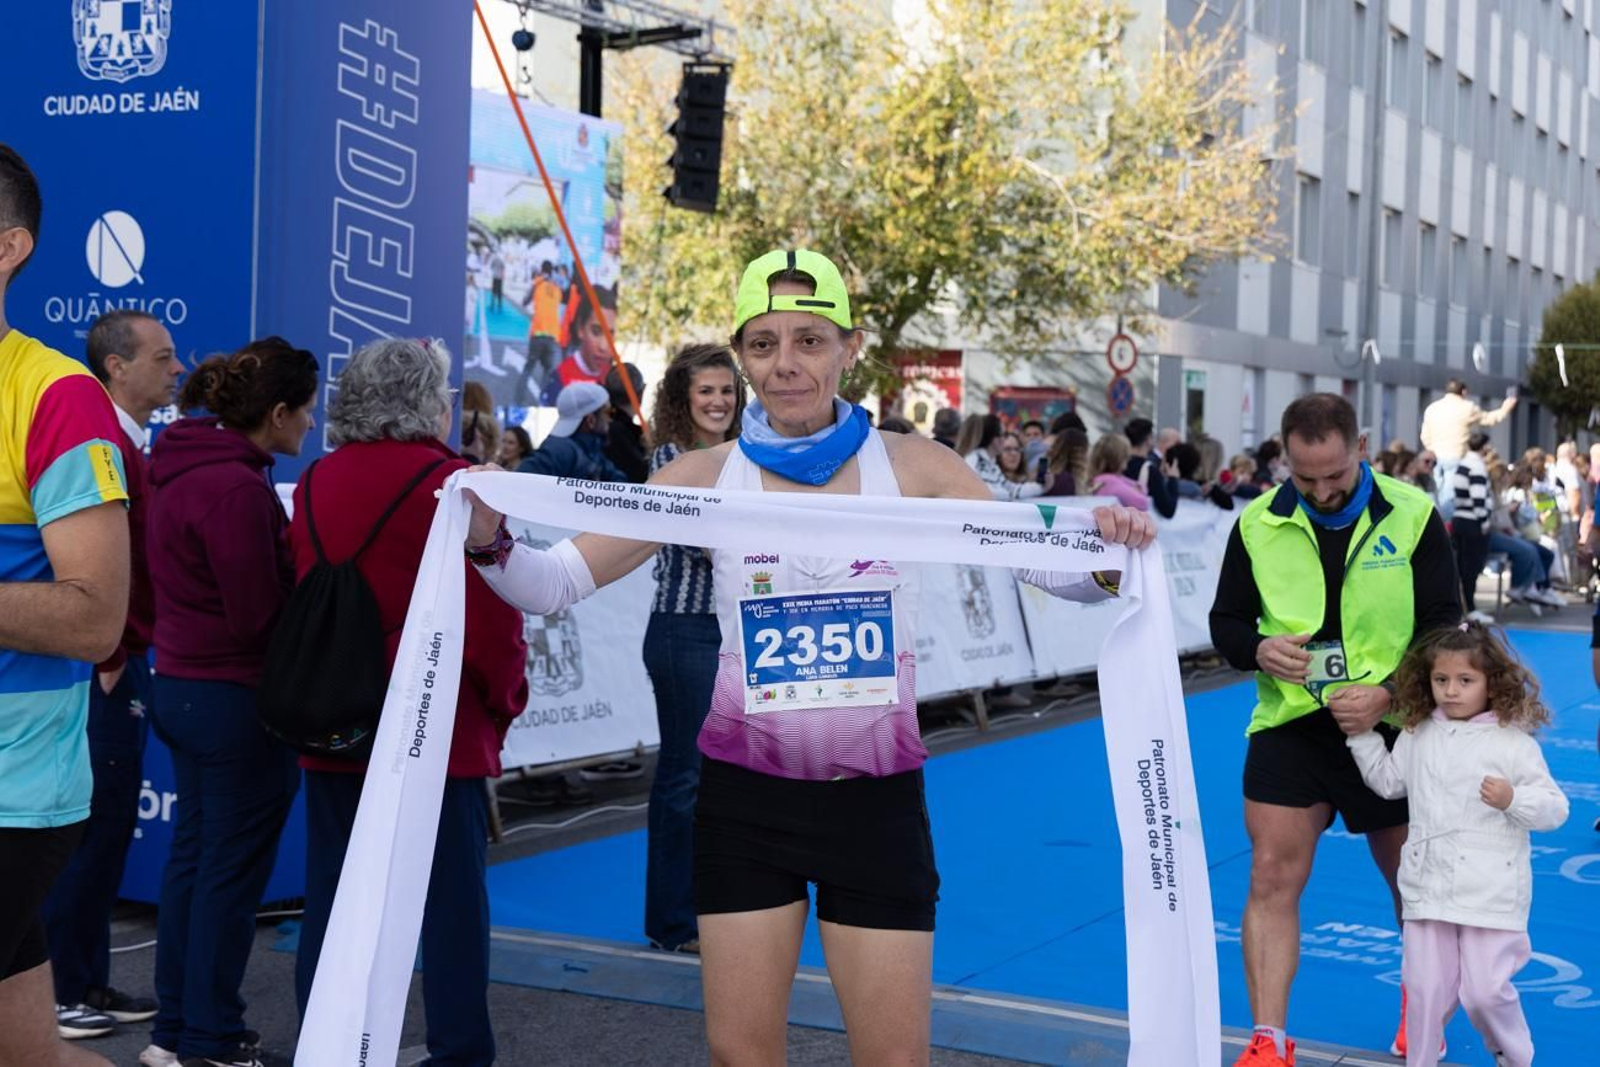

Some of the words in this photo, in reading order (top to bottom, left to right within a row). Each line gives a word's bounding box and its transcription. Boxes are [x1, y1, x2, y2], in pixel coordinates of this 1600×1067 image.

[43, 96, 116, 117] CIUDAD
[119, 92, 146, 114] DE
[148, 85, 200, 112] JAÉN
[556, 475, 626, 493] Patronato
[573, 490, 640, 510] Deportes
[643, 501, 662, 513] de
[665, 501, 701, 517] Jaén
[962, 523, 1032, 540] Patronato
[1050, 534, 1069, 548] de
[1072, 537, 1105, 554] Jaén
[744, 553, 780, 565] mobel
[426, 631, 444, 668] Jaén
[754, 621, 884, 669] 2350
[423, 670, 436, 689] de
[795, 666, 817, 676] ANA
[561, 705, 580, 723] DE
[581, 698, 614, 721] JAÉN
[409, 692, 432, 759] Deportes
[1151, 739, 1169, 810] Patronato
[1137, 759, 1159, 826] Deportes
[1148, 829, 1160, 849] de
[1161, 814, 1178, 888] Municipal
[1150, 853, 1164, 890] Jaén
[1168, 892, 1178, 912] de
